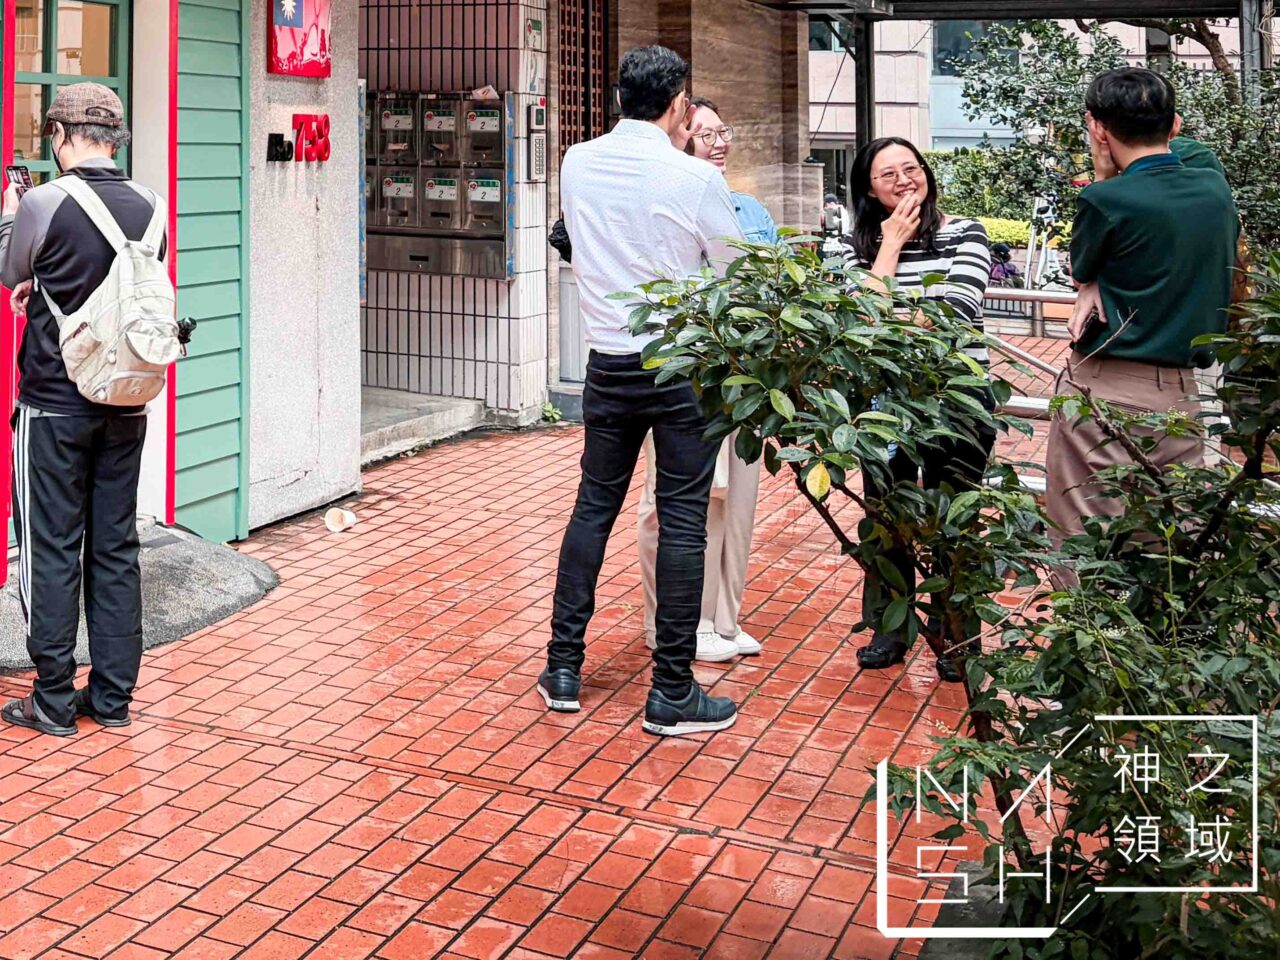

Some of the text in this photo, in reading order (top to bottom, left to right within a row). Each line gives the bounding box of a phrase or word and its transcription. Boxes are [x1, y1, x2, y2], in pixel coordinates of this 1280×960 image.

[394, 119, 400, 128] 2
[437, 121, 443, 129] 2
[480, 122, 486, 130] 2
[292, 114, 331, 162] 758
[395, 187, 401, 196] 2
[438, 190, 444, 199] 2
[481, 191, 487, 200] 2
